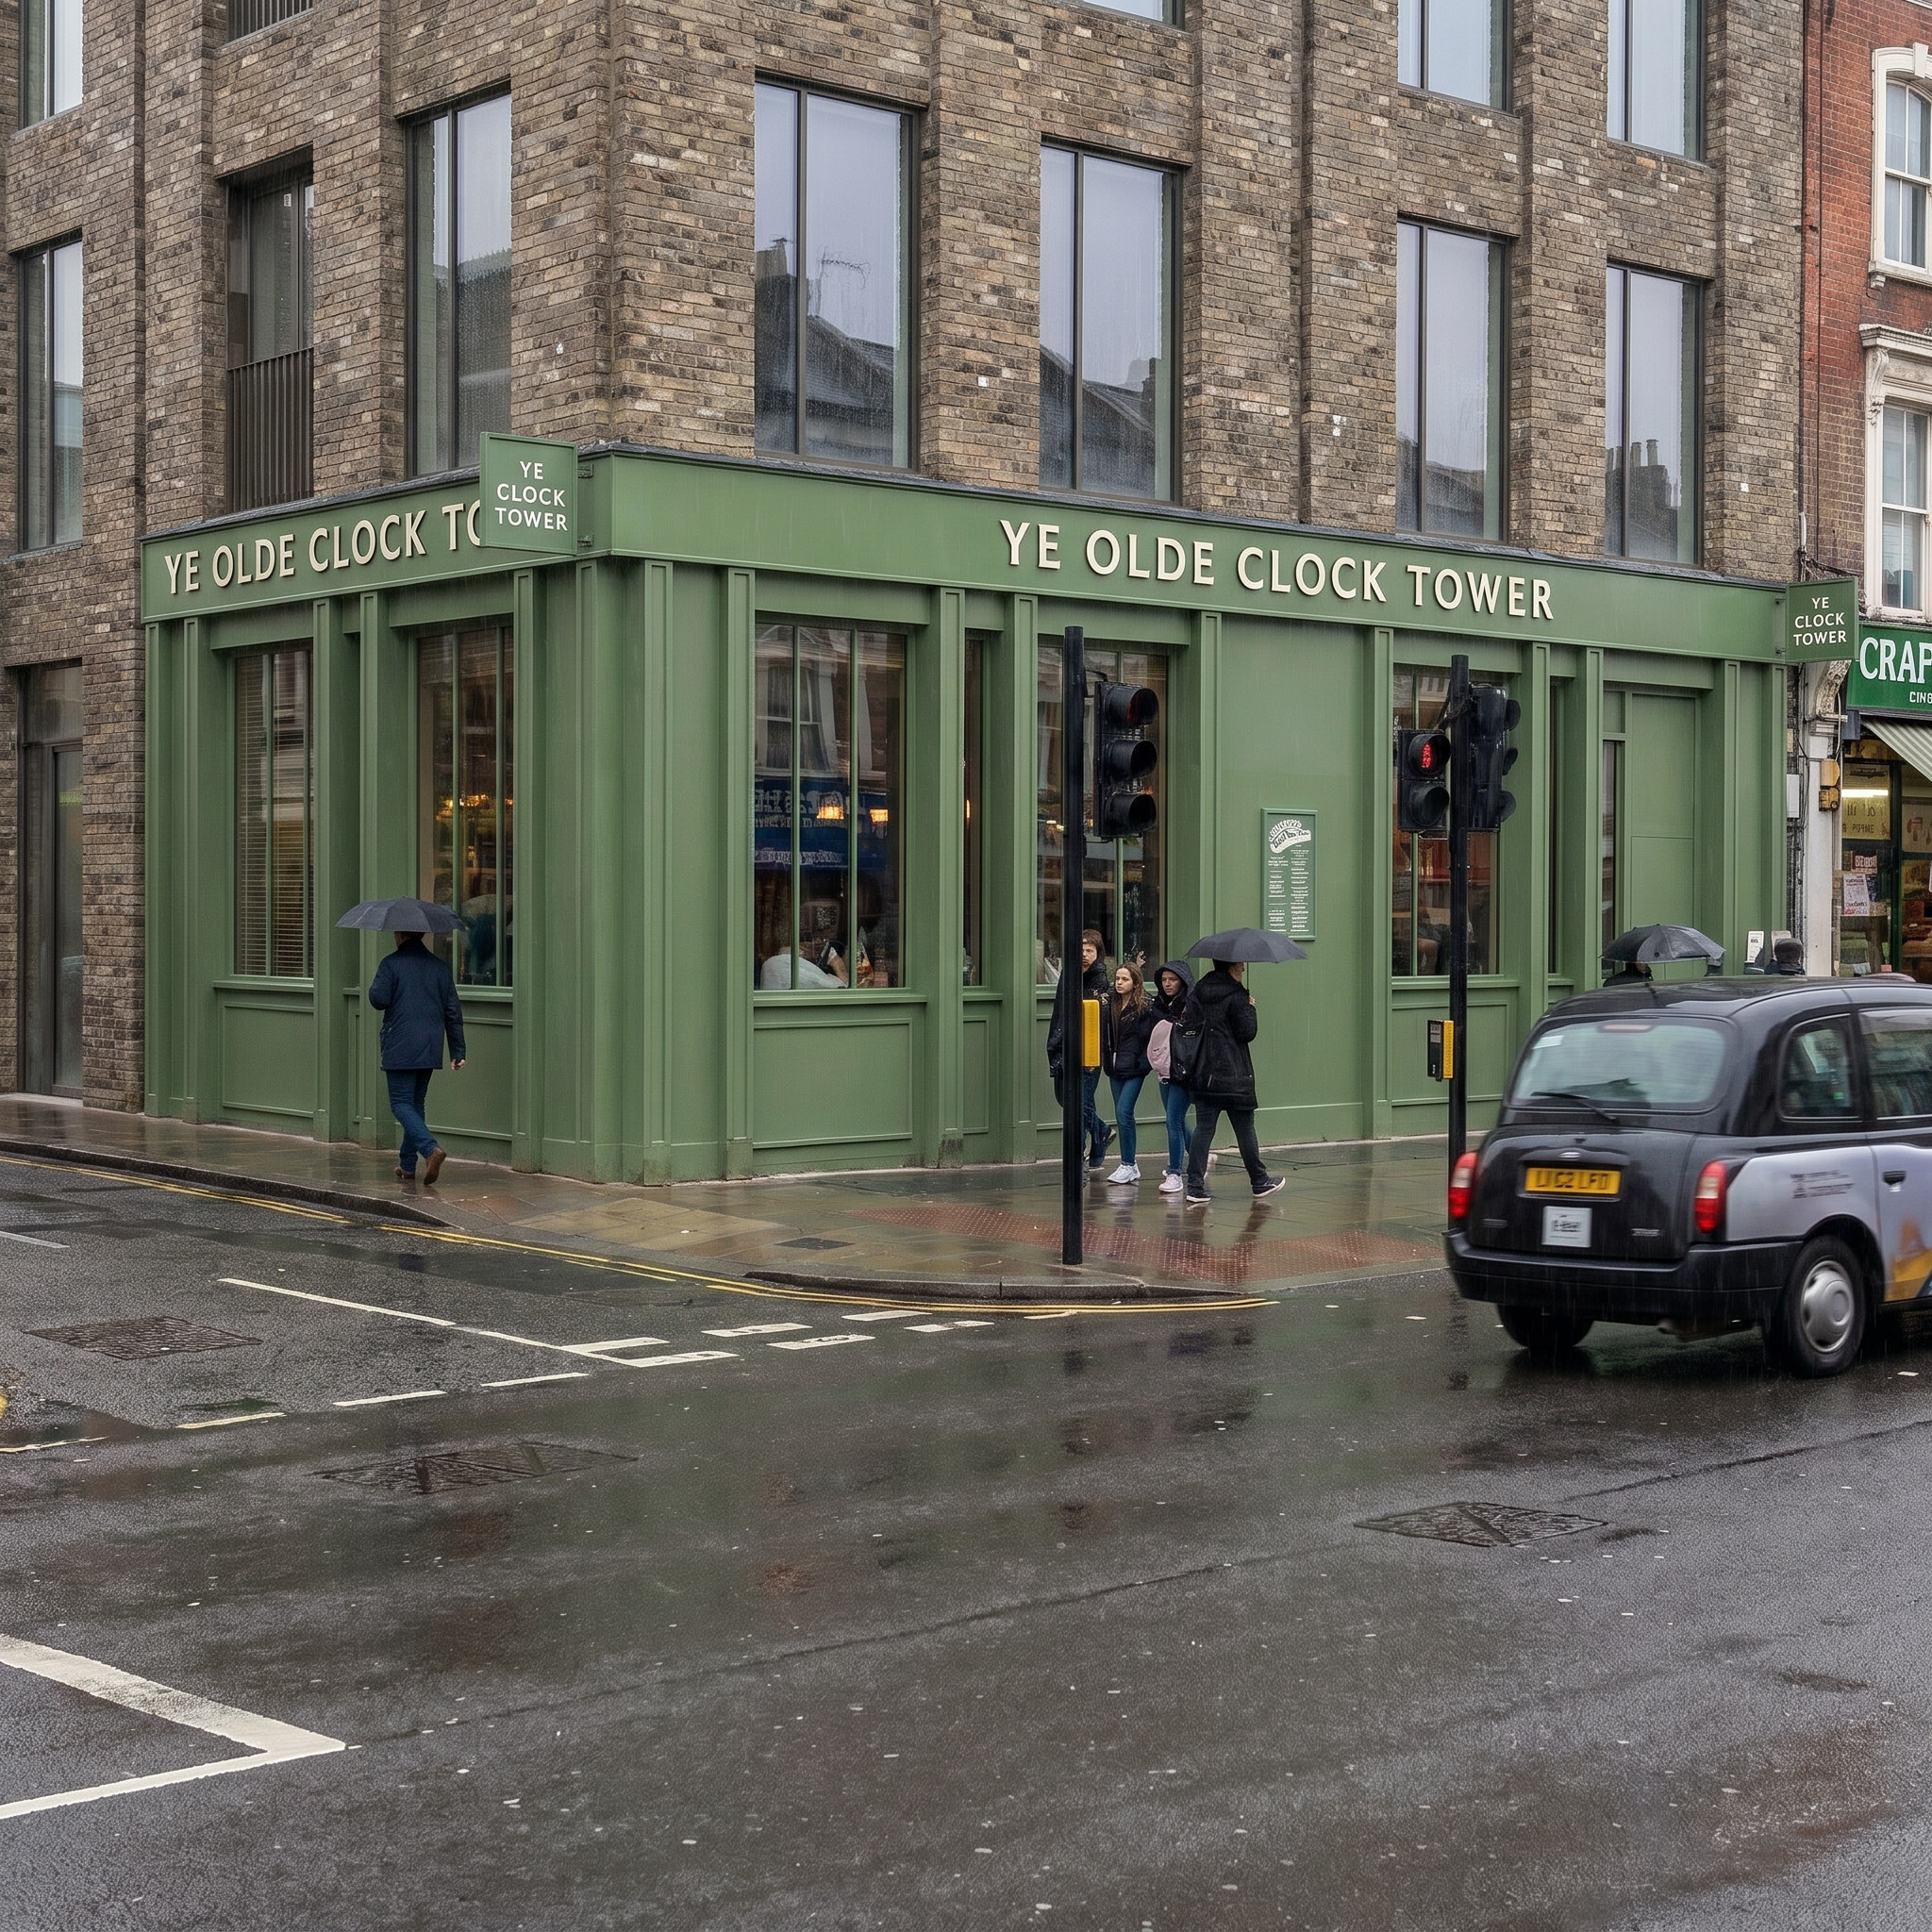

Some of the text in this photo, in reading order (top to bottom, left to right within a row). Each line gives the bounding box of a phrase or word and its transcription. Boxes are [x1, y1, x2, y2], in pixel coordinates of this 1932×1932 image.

[519, 460, 544, 480] YE
[496, 482, 566, 508] CLOCK
[493, 507, 568, 531] TOWER
[164, 550, 200, 594] YE
[212, 533, 295, 588] OLDE
[308, 509, 426, 572] CLOCK
[999, 519, 1555, 620] YE OLDE CLOCK TOWER
[1811, 597, 1830, 609] YE
[1794, 612, 1845, 629] CLOCK
[1792, 630, 1847, 646] TOWER
